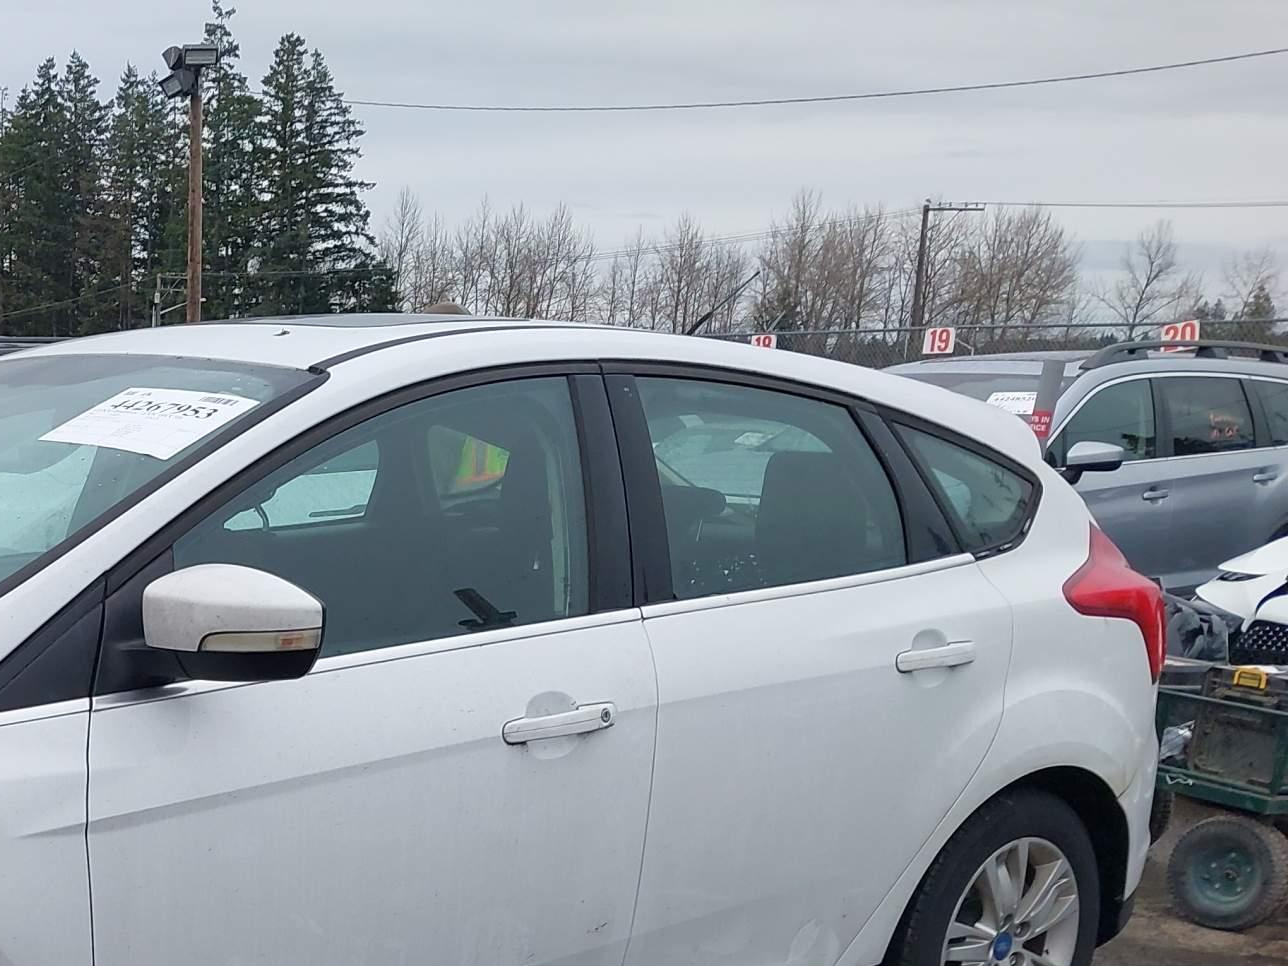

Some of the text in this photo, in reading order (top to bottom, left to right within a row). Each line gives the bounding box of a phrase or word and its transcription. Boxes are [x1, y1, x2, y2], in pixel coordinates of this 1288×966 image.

[930, 329, 951, 352] 19
[1165, 322, 1196, 351] 20
[112, 400, 218, 419] 44267953
